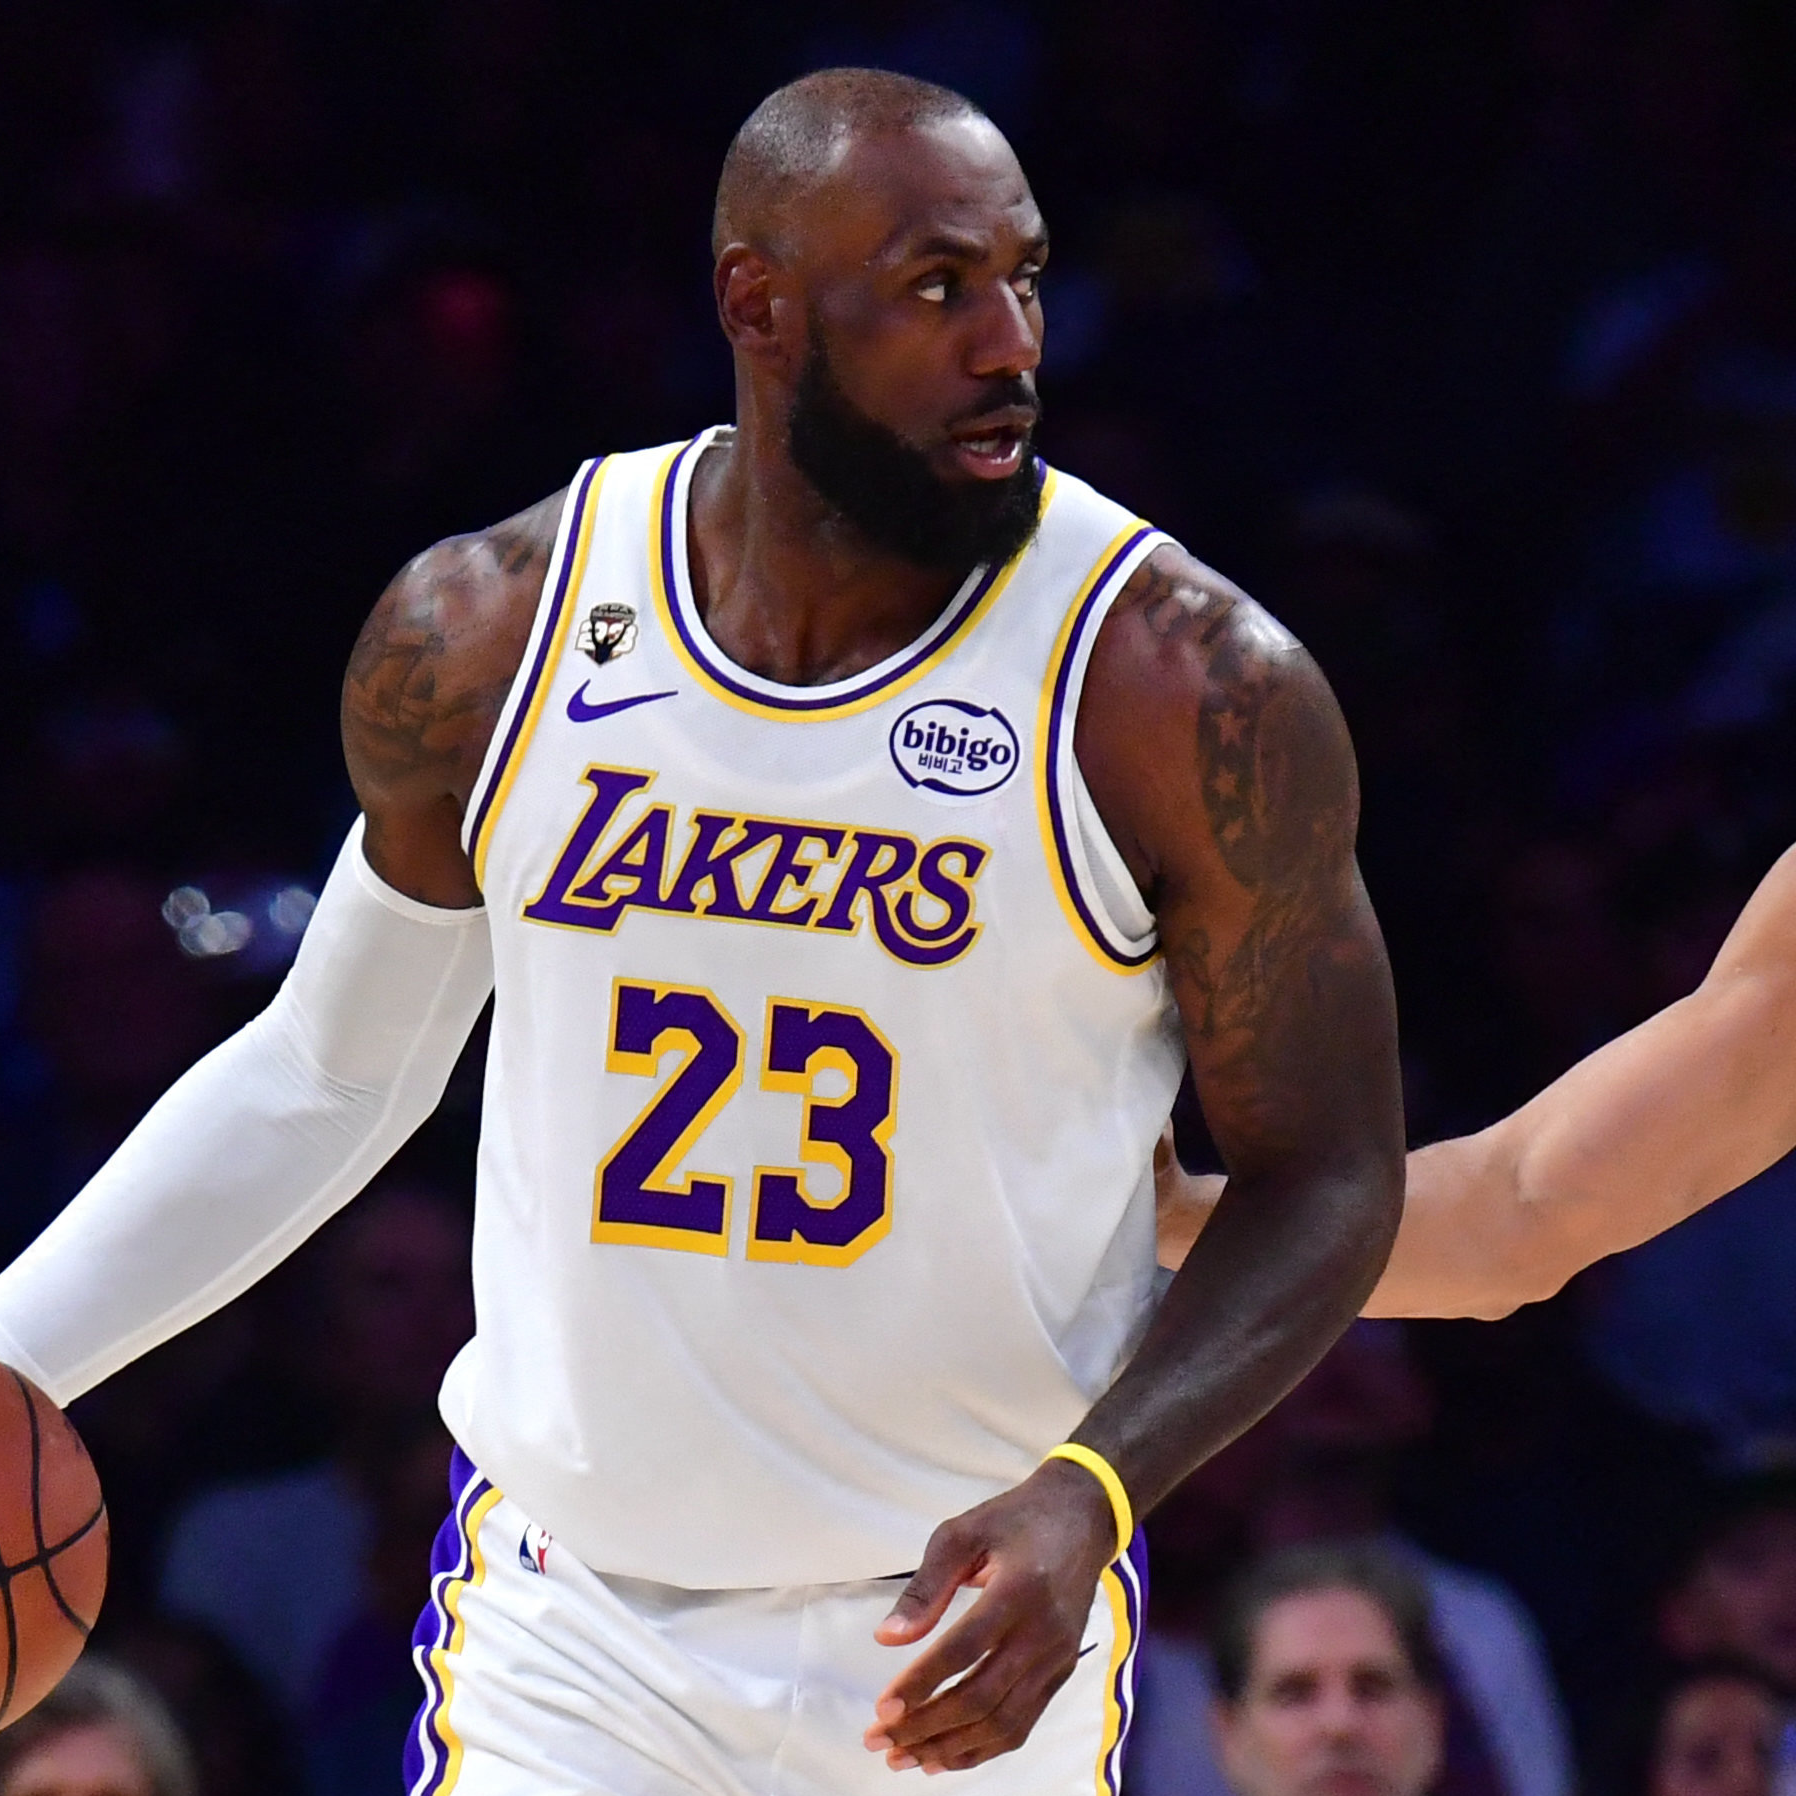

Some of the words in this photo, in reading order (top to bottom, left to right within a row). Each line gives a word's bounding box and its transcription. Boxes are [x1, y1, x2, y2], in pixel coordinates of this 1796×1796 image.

[903, 720, 1011, 771] bibigo
[918, 753, 962, 774] 비비고
[520, 762, 993, 970] LAKERS
[590, 976, 900, 1268] 23
